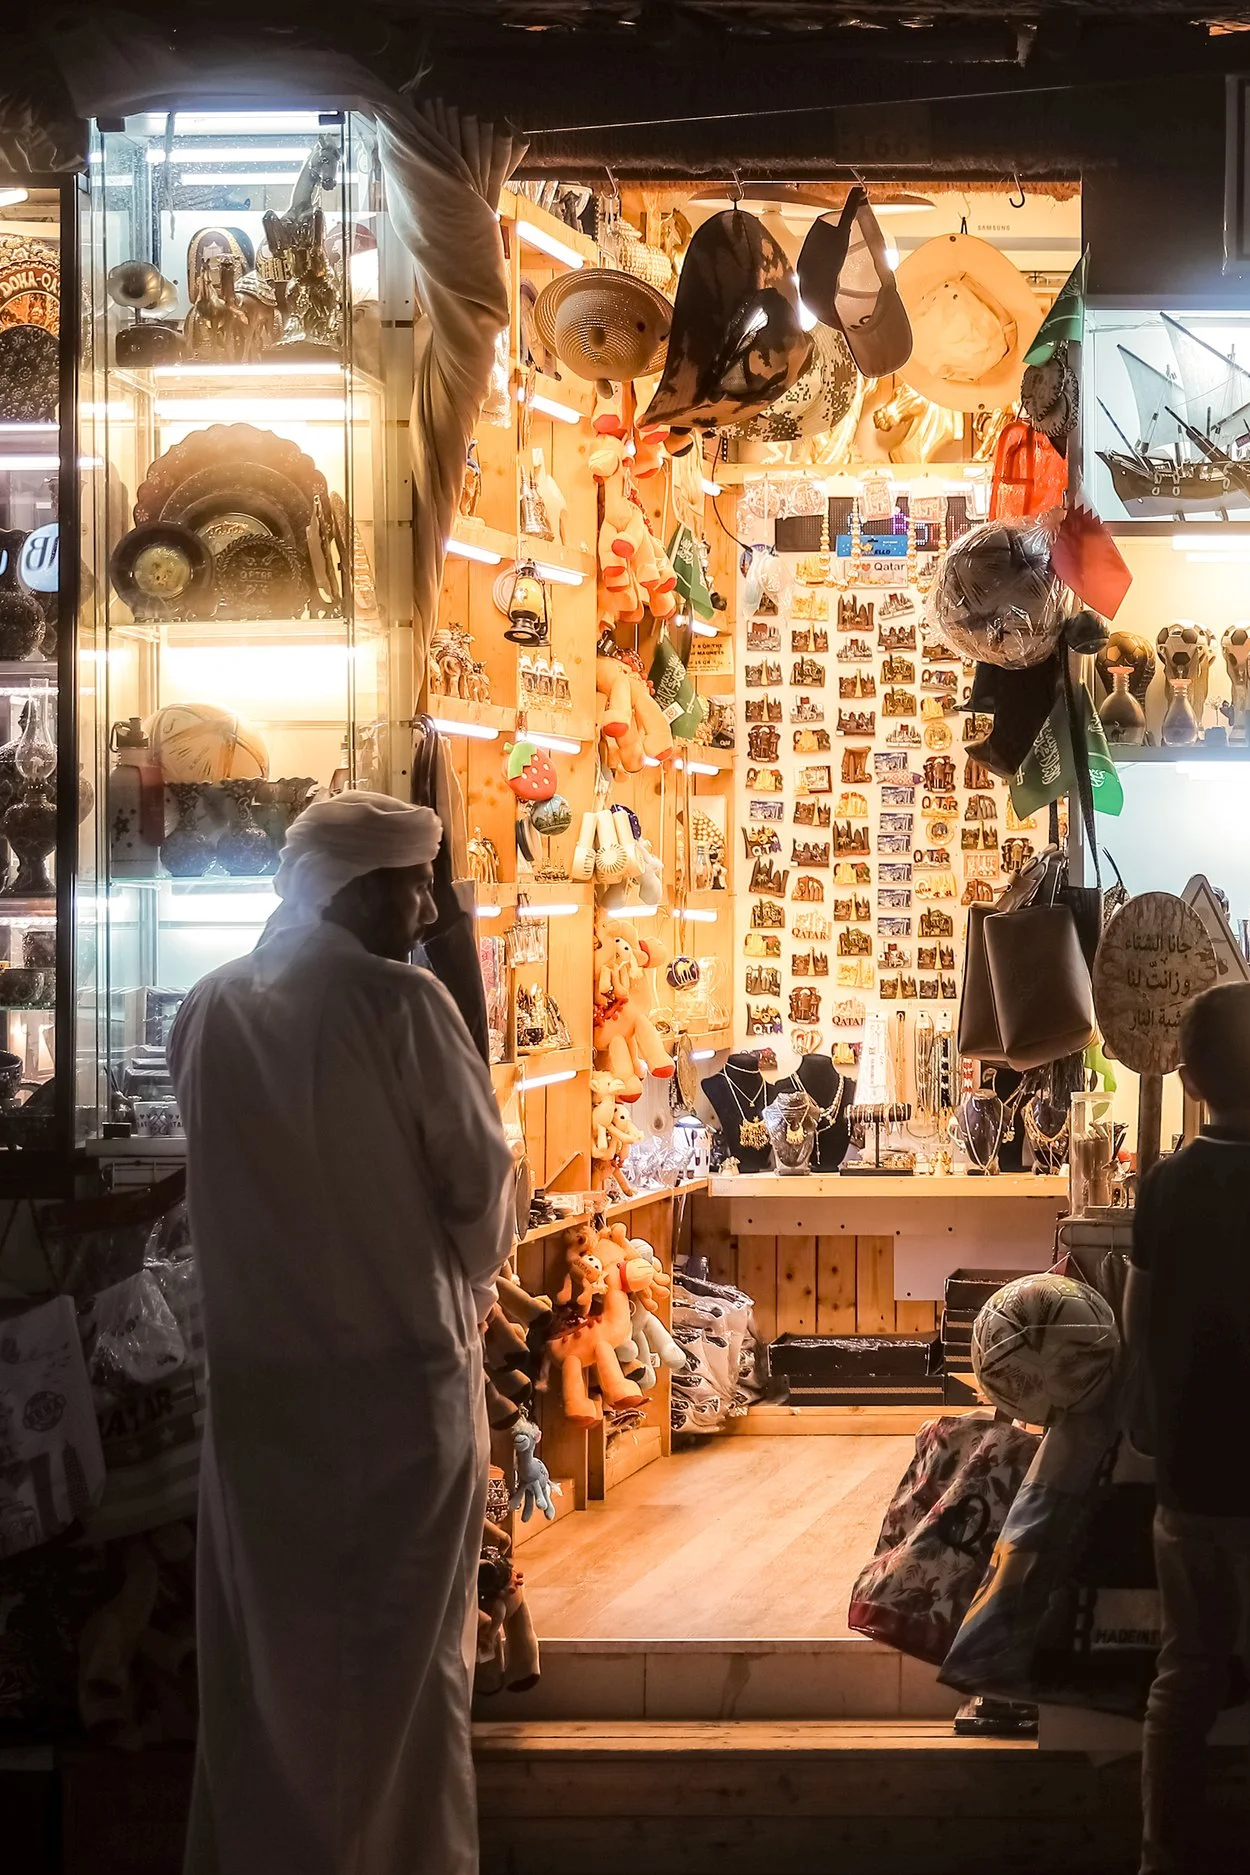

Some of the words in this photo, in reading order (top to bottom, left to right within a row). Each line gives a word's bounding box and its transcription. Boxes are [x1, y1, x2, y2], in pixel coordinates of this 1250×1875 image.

[0, 270, 60, 299] DOHA-QA
[873, 562, 906, 571] Qatar
[791, 927, 827, 940] QATAR
[98, 1389, 174, 1439] ATAR
